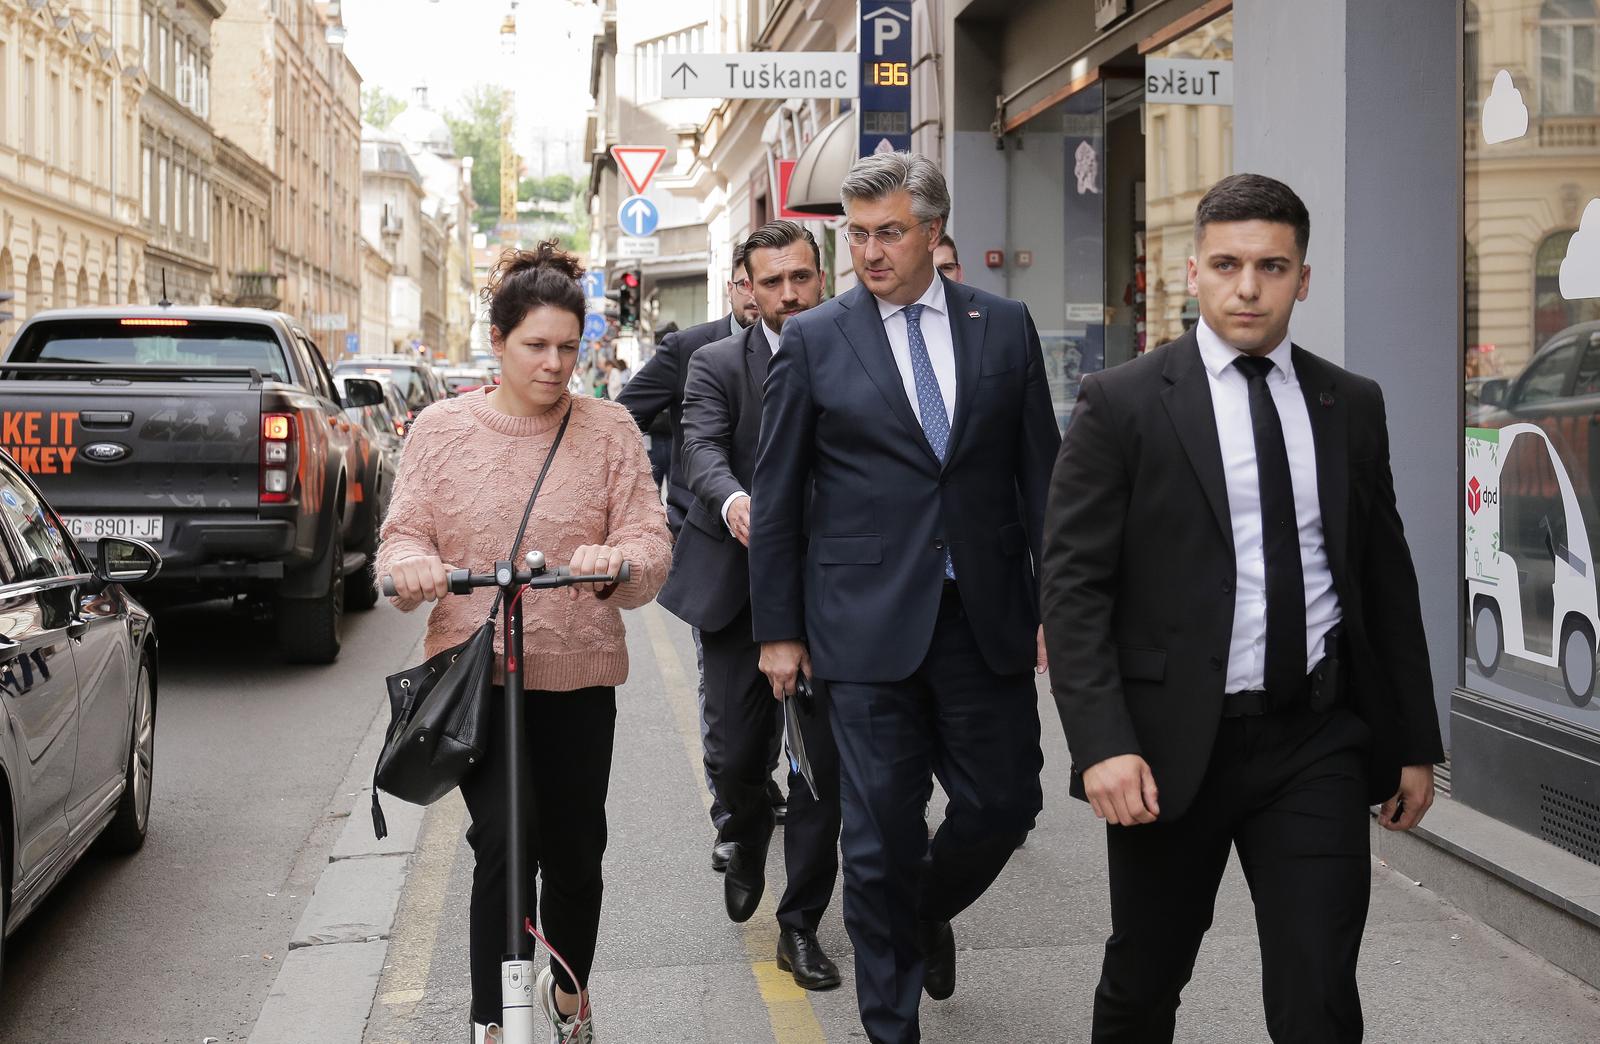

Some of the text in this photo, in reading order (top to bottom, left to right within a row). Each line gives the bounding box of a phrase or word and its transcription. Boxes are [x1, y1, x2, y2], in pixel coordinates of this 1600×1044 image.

[873, 17, 901, 56] P
[725, 62, 848, 89] Tuškanac
[873, 62, 910, 87] 136
[0, 411, 80, 445] KE IT
[1482, 485, 1498, 508] dpd
